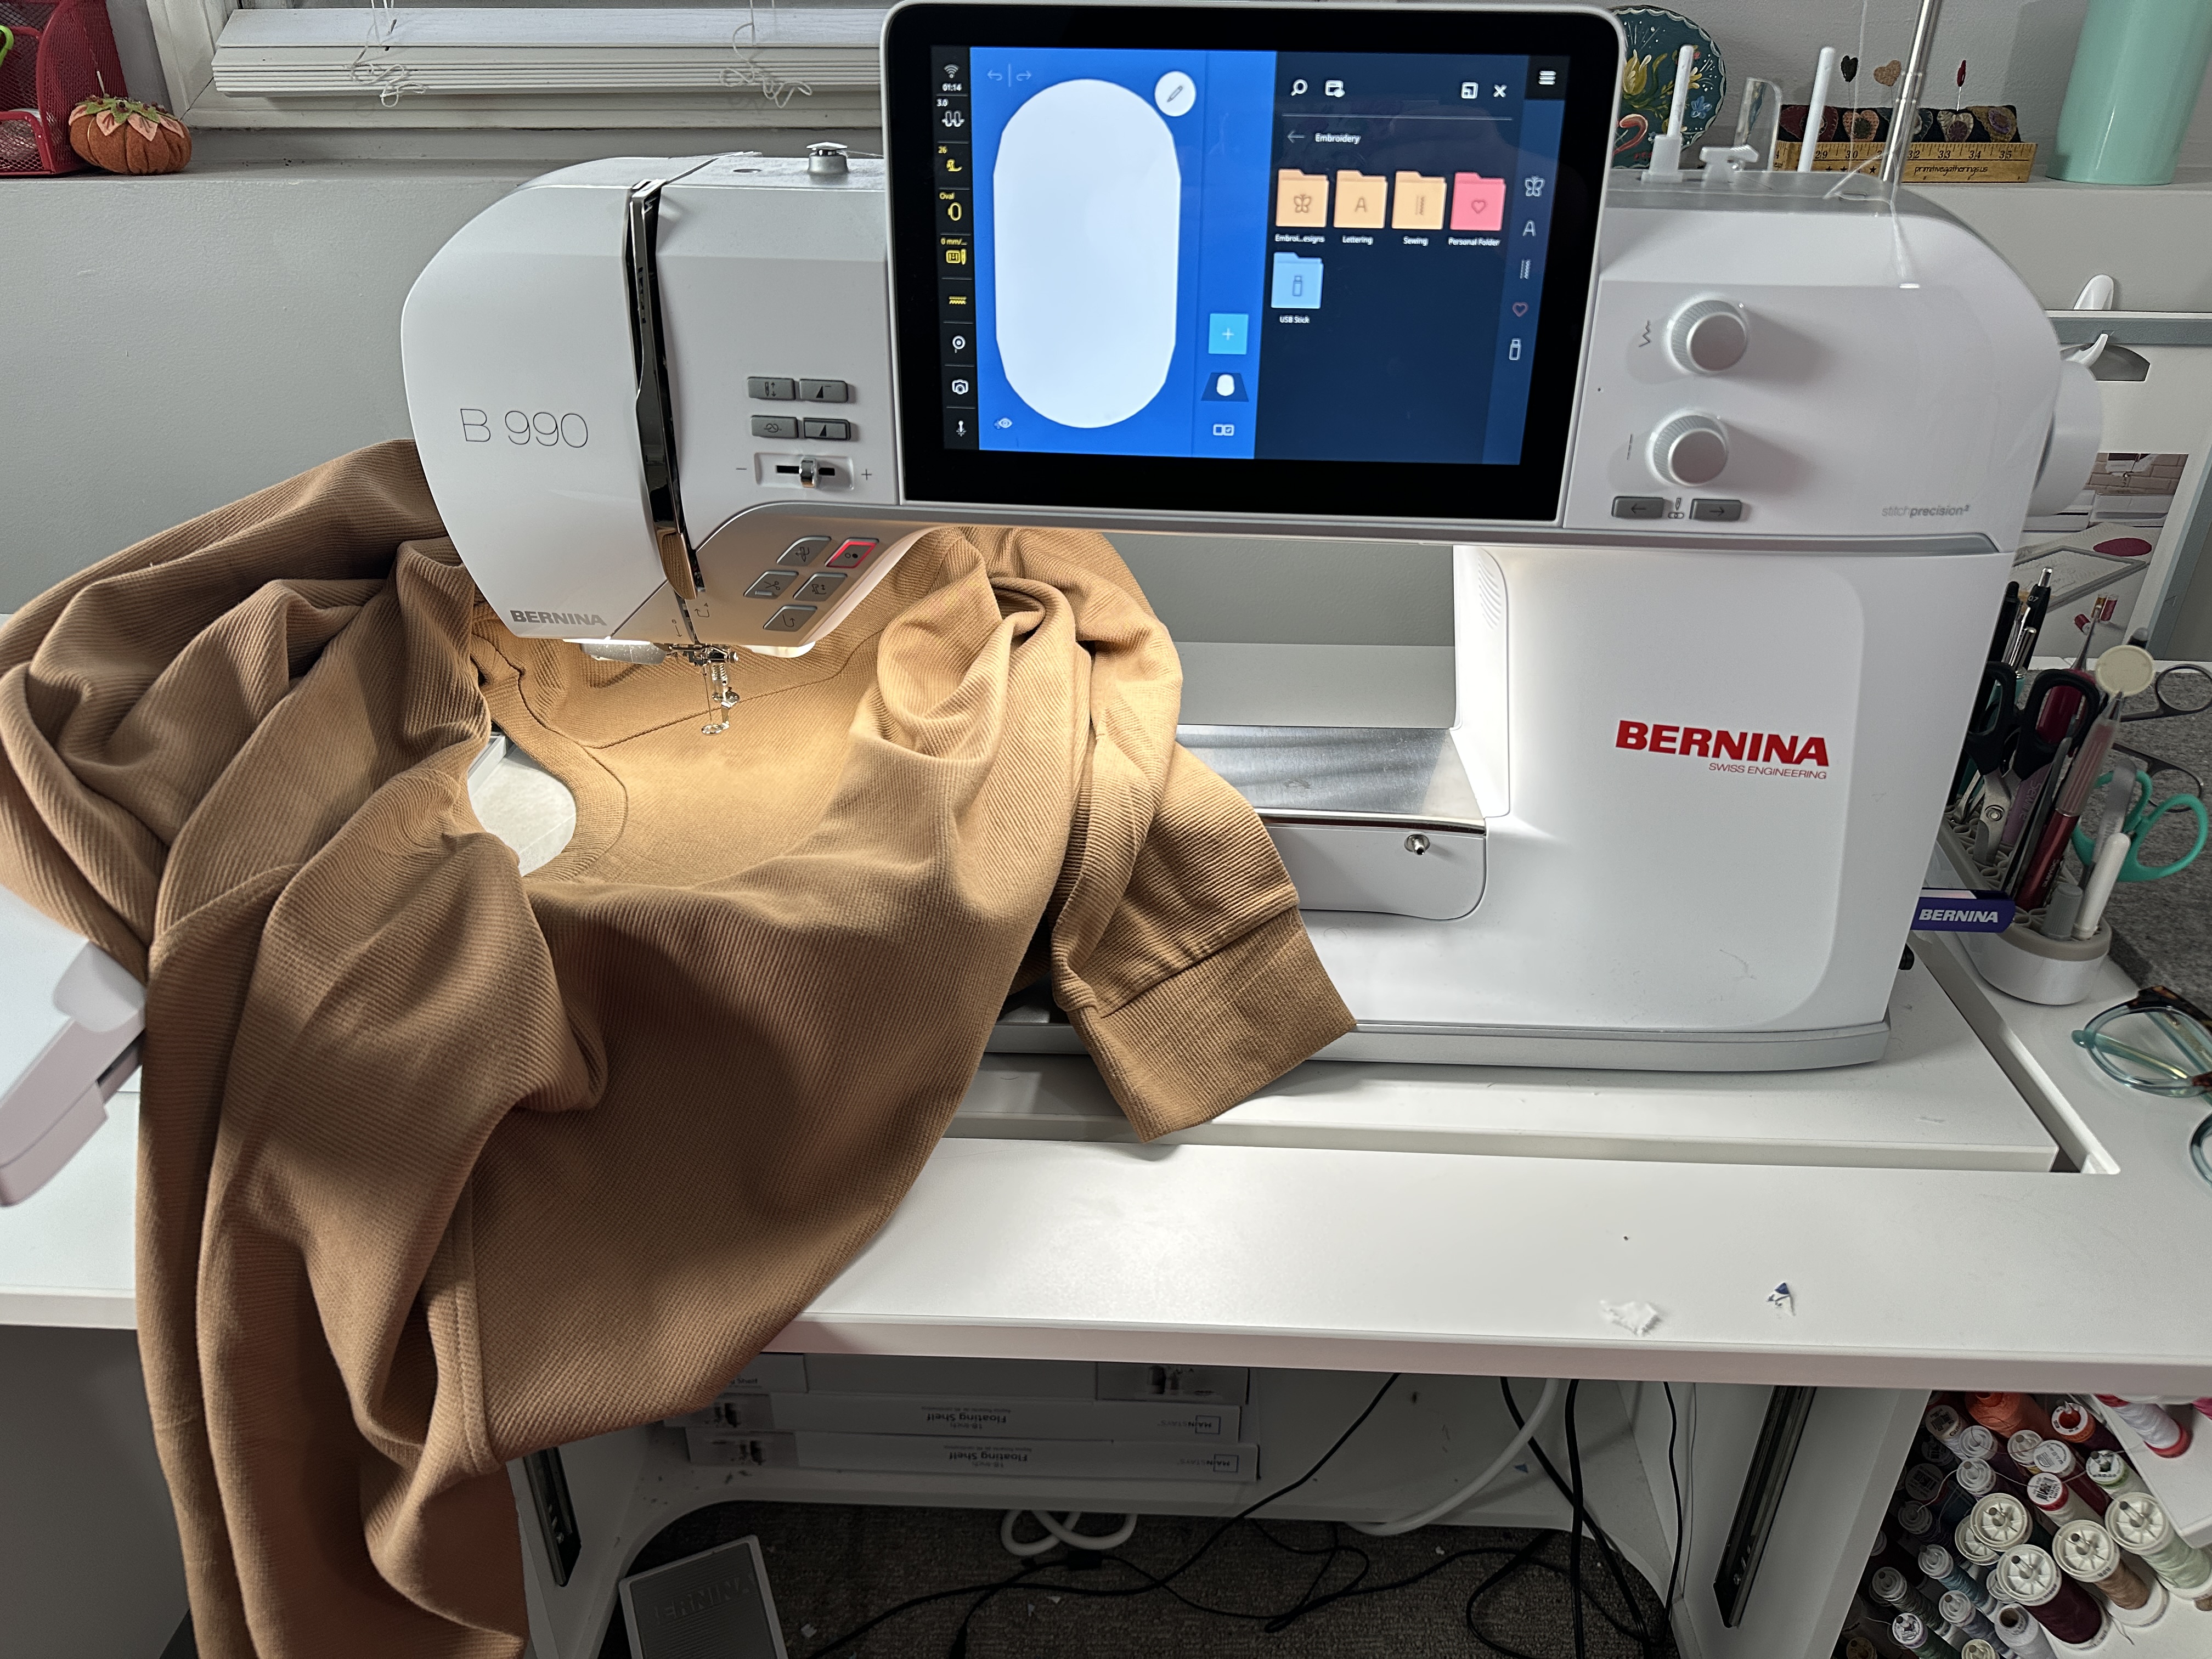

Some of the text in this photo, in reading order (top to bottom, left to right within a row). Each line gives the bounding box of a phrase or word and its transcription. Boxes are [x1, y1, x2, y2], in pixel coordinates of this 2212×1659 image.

[942, 83, 962, 91] 01:14
[1315, 133, 1361, 144] Embroidery
[1908, 150, 1920, 159] 32
[1938, 150, 1951, 159] 33
[1968, 150, 1981, 159] 34
[1999, 150, 2012, 159] 35
[1342, 235, 1373, 245] Lettering
[1403, 236, 1429, 246] Sewing
[1448, 237, 1500, 246] Personal Folder
[1280, 315, 1310, 323] USB Stick
[460, 409, 588, 448] B 990
[510, 610, 607, 626] BERNINA
[1615, 720, 1829, 767] BERNINA
[1708, 763, 1827, 780] SWISS ENGINEERING
[1918, 909, 1998, 923] BERNINA
[927, 1412, 1007, 1424] Floating Shelf
[949, 1451, 1028, 1462] Floating Shelf
